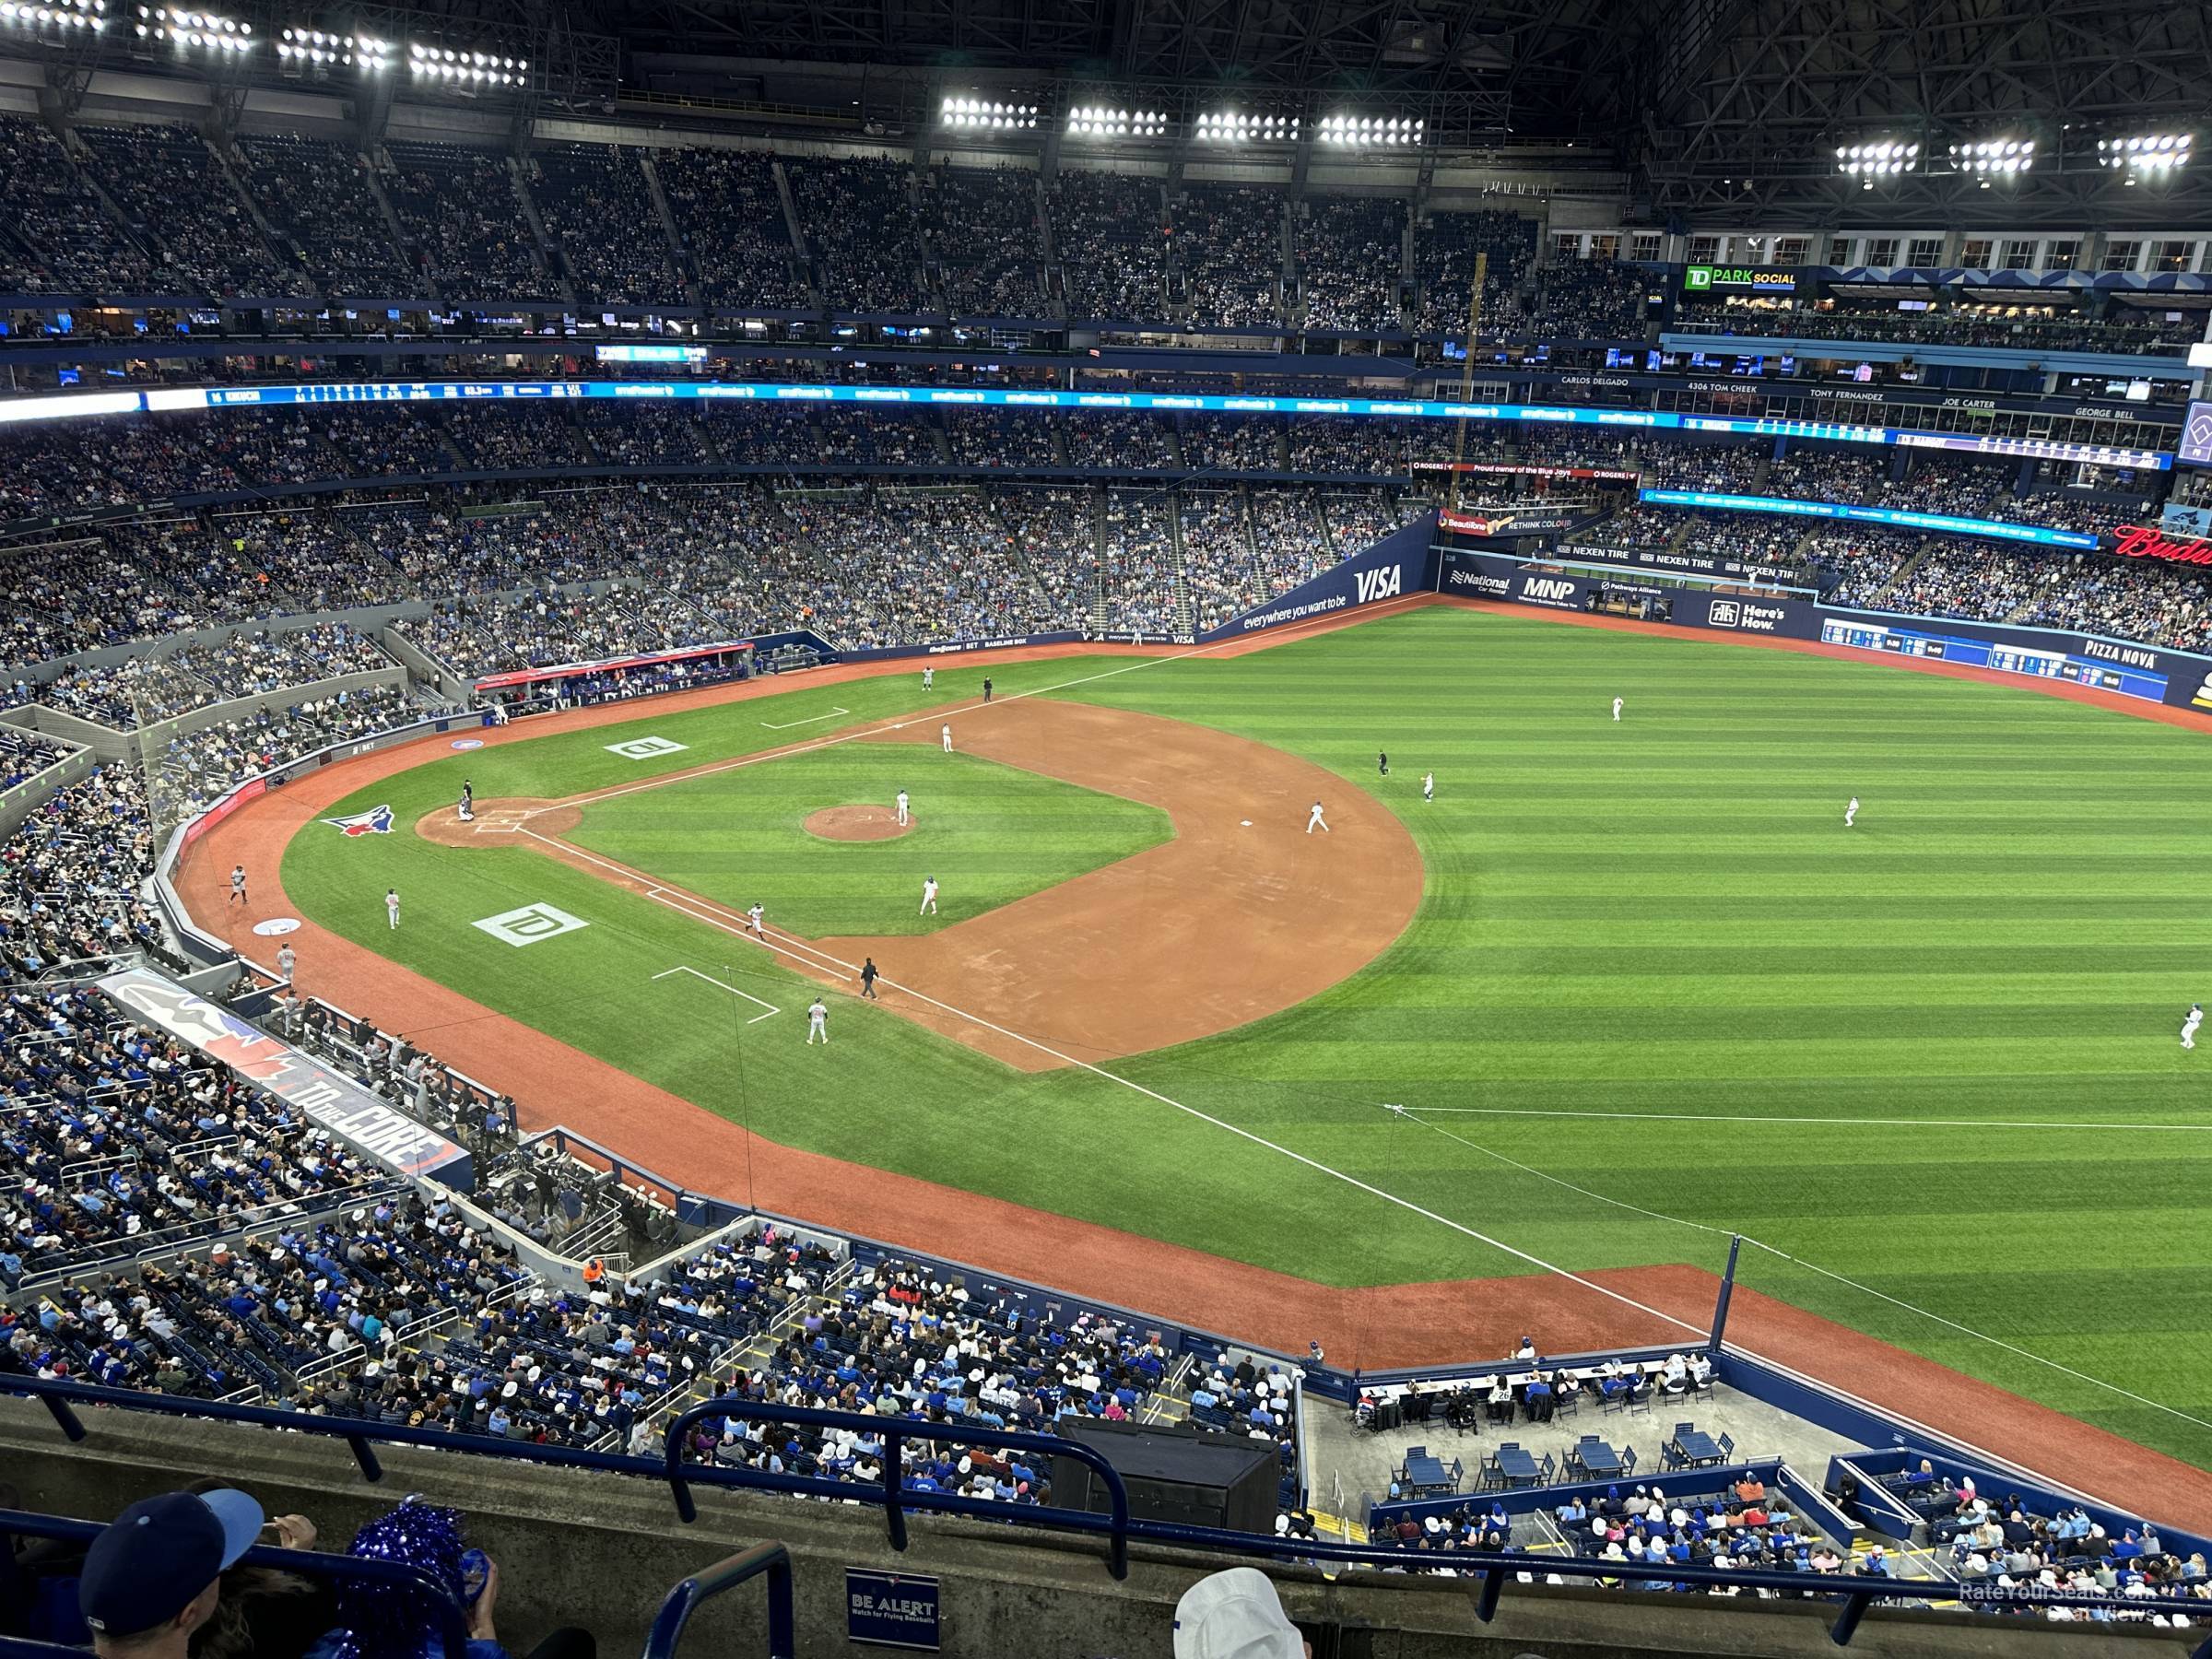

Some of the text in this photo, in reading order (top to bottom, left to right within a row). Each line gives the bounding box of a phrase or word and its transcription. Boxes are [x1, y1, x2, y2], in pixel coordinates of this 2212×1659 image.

[1688, 269, 1710, 286] TD
[1712, 268, 1796, 285] PARK SOCIAL
[1561, 376, 1629, 386] CARLOS DELGADO
[1688, 382, 1757, 394] 4306 TOM CHEEK
[1810, 389, 1884, 401] TONY FERNANDEZ
[1942, 398, 1995, 409] JOE CARTER
[2075, 407, 2135, 419] GEORGE BELL
[1475, 465, 1493, 473] Proud
[1525, 466, 1537, 475] the
[1554, 468, 1571, 477] Jays
[1601, 471, 1625, 479] ROGERS
[1448, 519, 1486, 531] BeautiTone
[1508, 519, 1572, 530] RETHINK COLOUR
[1573, 547, 1605, 558] NEXEN
[1607, 549, 1630, 559] TIRE
[1656, 555, 1689, 566] NEXEN
[1691, 559, 1713, 569] TIRE
[1743, 564, 1776, 577] NEXEN
[1778, 569, 1799, 580] TIRE
[1354, 565, 1401, 604] VISA
[1463, 572, 1510, 589] National
[1524, 578, 1575, 599] MNP
[1611, 583, 1662, 594] Pathways Alliance
[1244, 594, 1347, 629] everywhere you want to be
[1743, 605, 1784, 619] Here's
[1741, 617, 1774, 630] How.
[1081, 632, 1104, 642] VA
[1172, 634, 1195, 644] VISA
[929, 644, 961, 653] theScore
[966, 641, 978, 650] BET
[984, 640, 1013, 649] BASELINE
[2084, 640, 2155, 669] PIZZA NOVA
[362, 742, 374, 752] BET
[500, 909, 564, 936] TD
[286, 1080, 446, 1166] TO THE CORE
[1499, 1391, 1510, 1400] 26
[852, 1594, 935, 1616] BE ALERT
[852, 1608, 872, 1618] Watch
[884, 1612, 903, 1621] Flying
[904, 1615, 935, 1624] Baseballs
